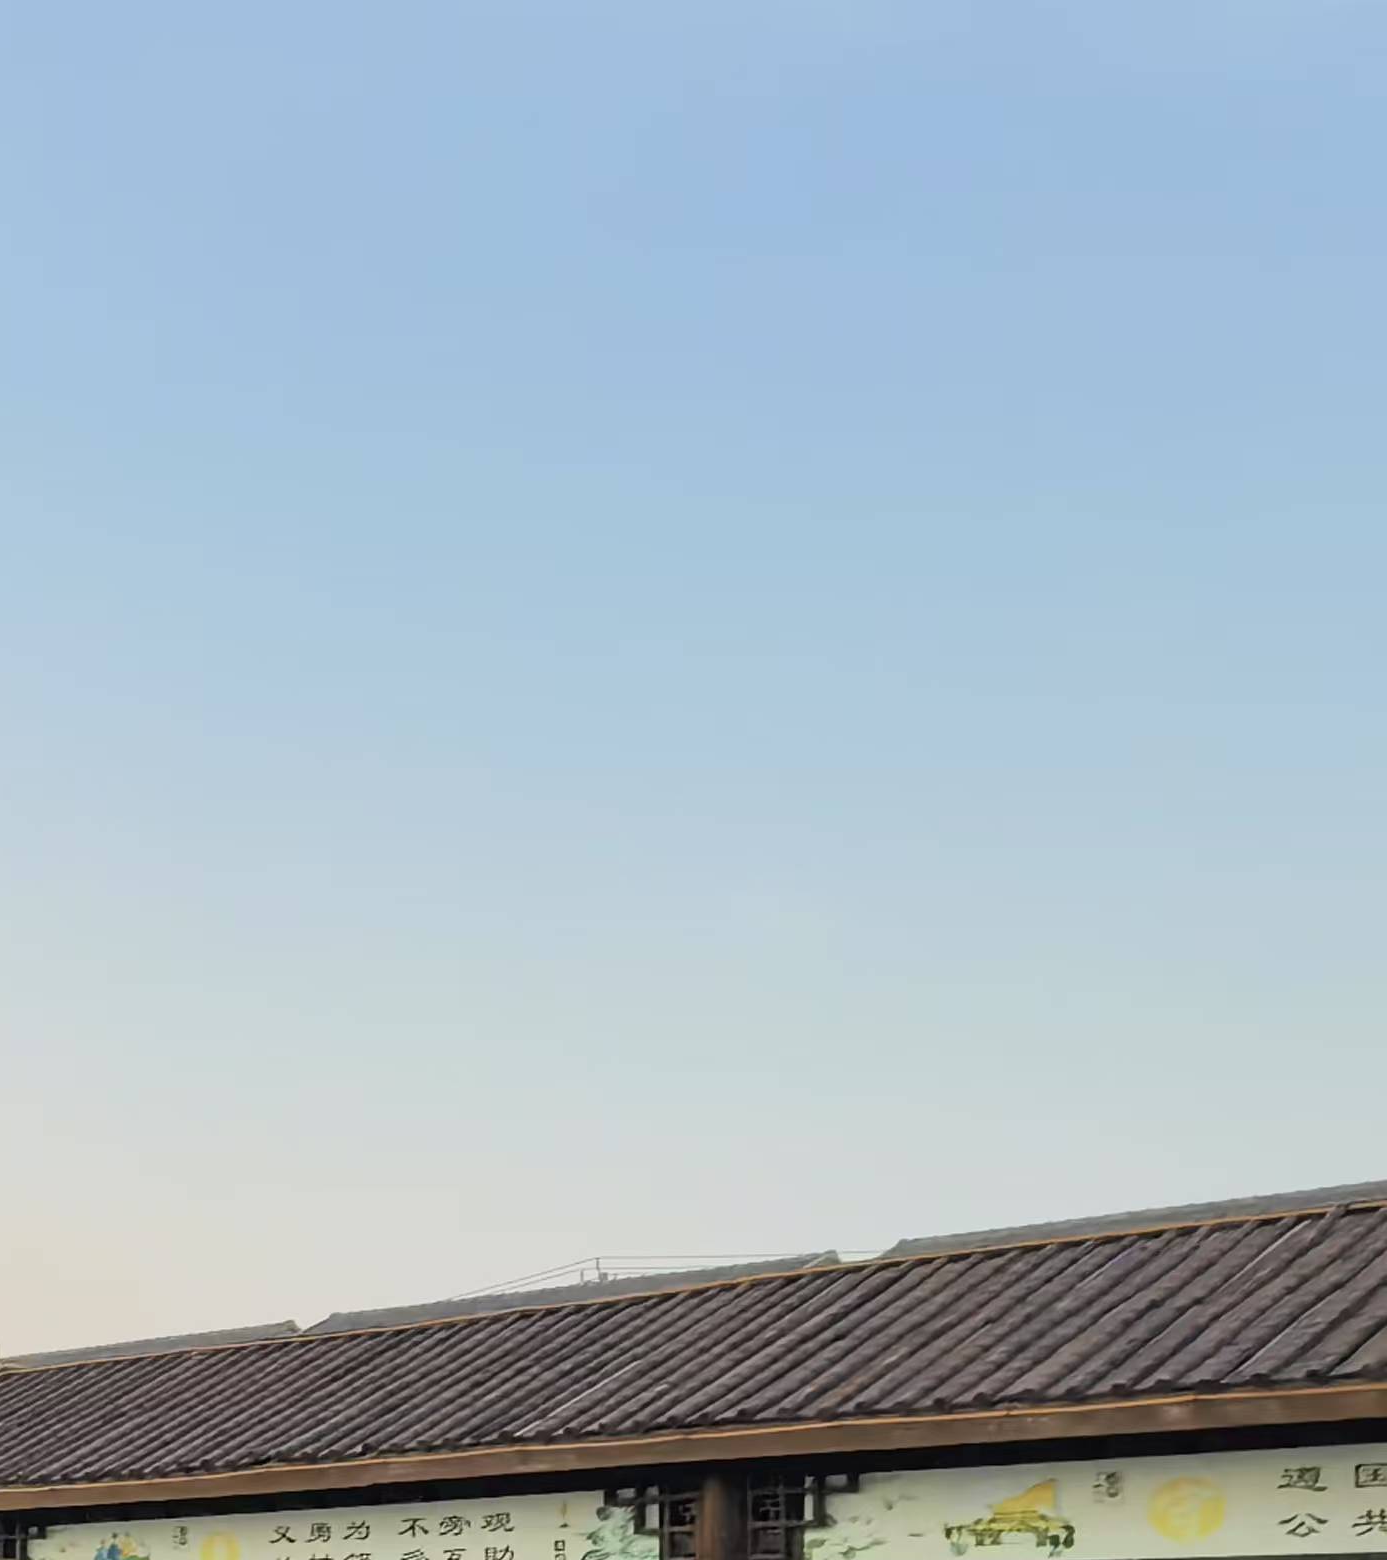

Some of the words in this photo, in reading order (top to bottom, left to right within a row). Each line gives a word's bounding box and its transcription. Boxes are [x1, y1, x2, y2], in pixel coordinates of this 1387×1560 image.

[269, 1520, 371, 1543] 义勇为
[398, 1512, 515, 1537] 不旁观
